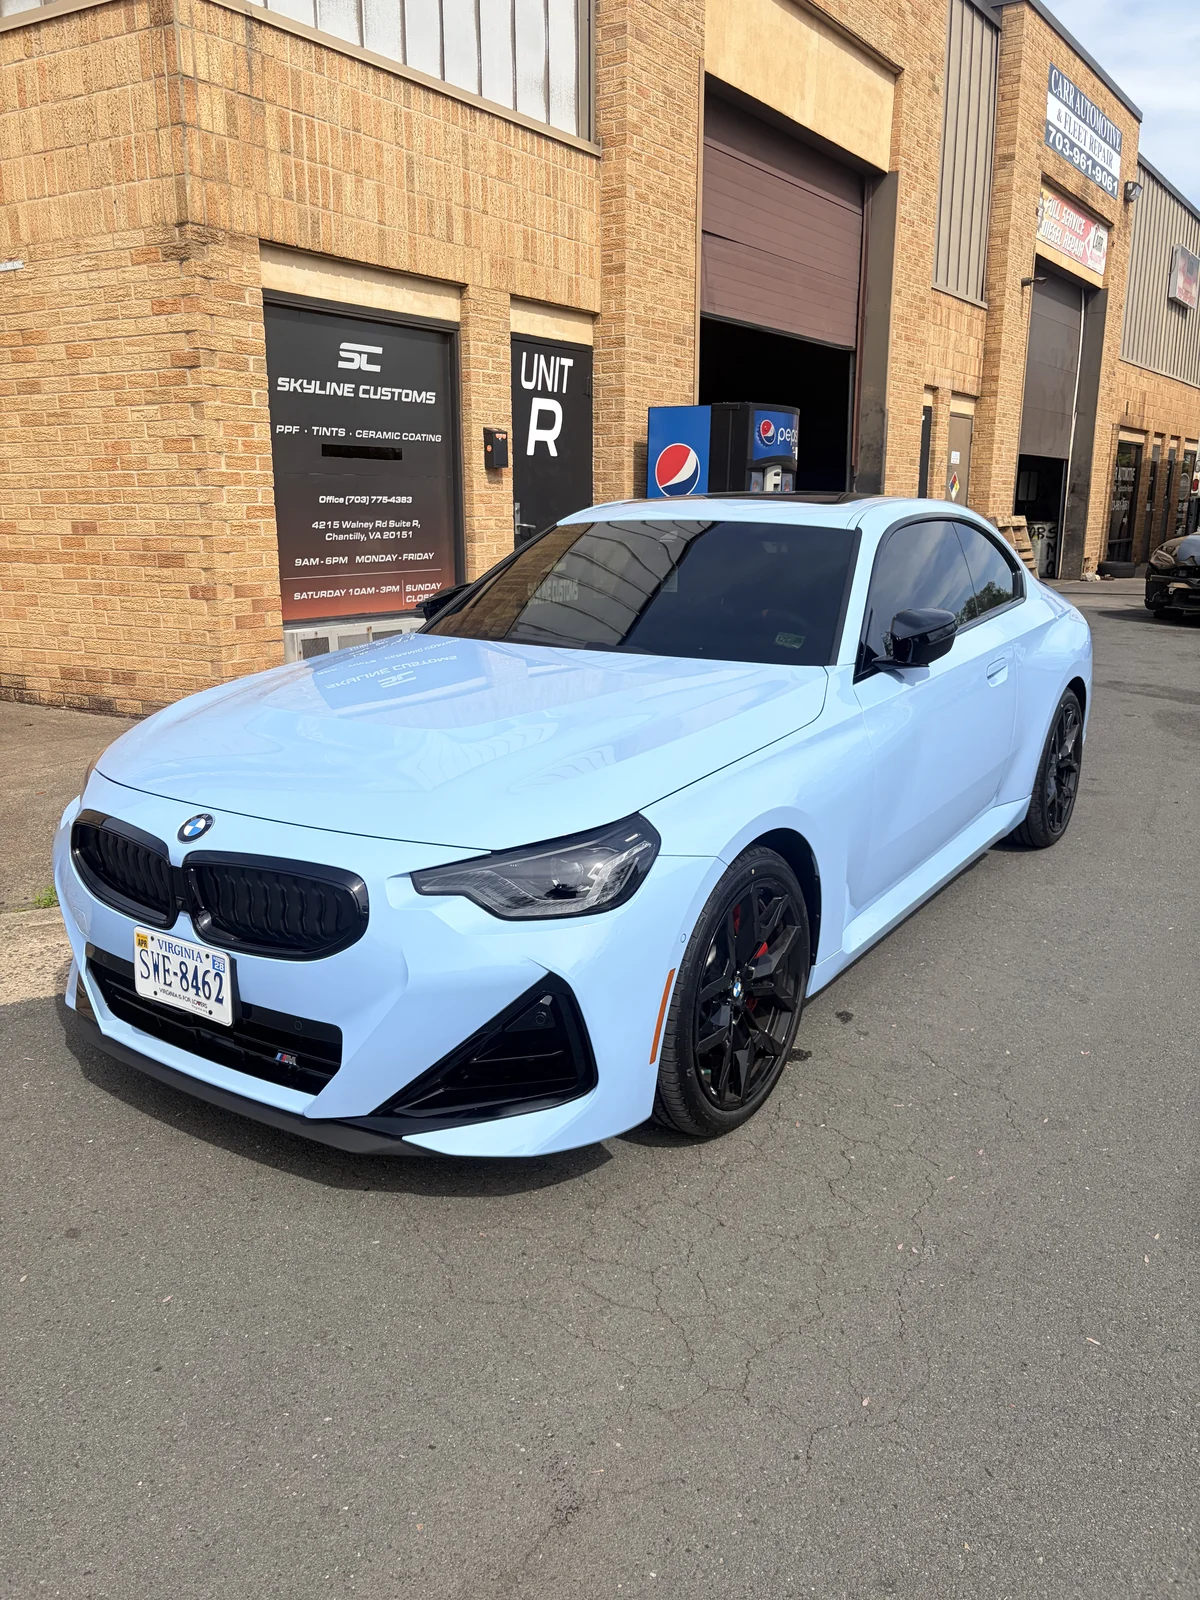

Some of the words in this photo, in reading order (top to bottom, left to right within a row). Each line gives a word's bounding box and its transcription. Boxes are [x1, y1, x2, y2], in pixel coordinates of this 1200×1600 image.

[1051, 69, 1074, 108] CARR
[1075, 90, 1121, 151] AUTOMOTIVE
[1057, 108, 1063, 123] &
[1064, 111, 1088, 147] FLEET
[1089, 133, 1113, 169] REPAIR
[1048, 125, 1118, 196] 703-961-9061
[1061, 206, 1085, 236] SERVICE
[1042, 220, 1063, 246] DIESEL
[1063, 231, 1085, 258] REPAIR
[520, 351, 574, 393] UNIT
[277, 377, 355, 397] SKYLINE
[358, 385, 436, 404] CUSTOMS
[276, 425, 300, 434] PPF
[312, 426, 346, 437] TINTS
[355, 430, 400, 440] CERAMIC
[401, 432, 442, 442] COATING
[526, 397, 563, 457] R
[777, 426, 798, 445] peps
[318, 495, 344, 504] Office
[345, 496, 370, 505] (703)
[370, 496, 413, 504] 775-4383
[311, 520, 340, 529] 4215
[341, 520, 374, 530] Walney
[375, 519, 388, 528] Rd
[388, 519, 411, 528] Suite
[325, 532, 367, 542] Chantilly,
[368, 532, 381, 540] VA
[383, 531, 413, 539] 20151
[293, 589, 347, 600] SATURDAY
[405, 582, 442, 592] SUNDAY
[157, 939, 203, 964] VIRGINIA
[139, 948, 225, 1006] SWE-8462
